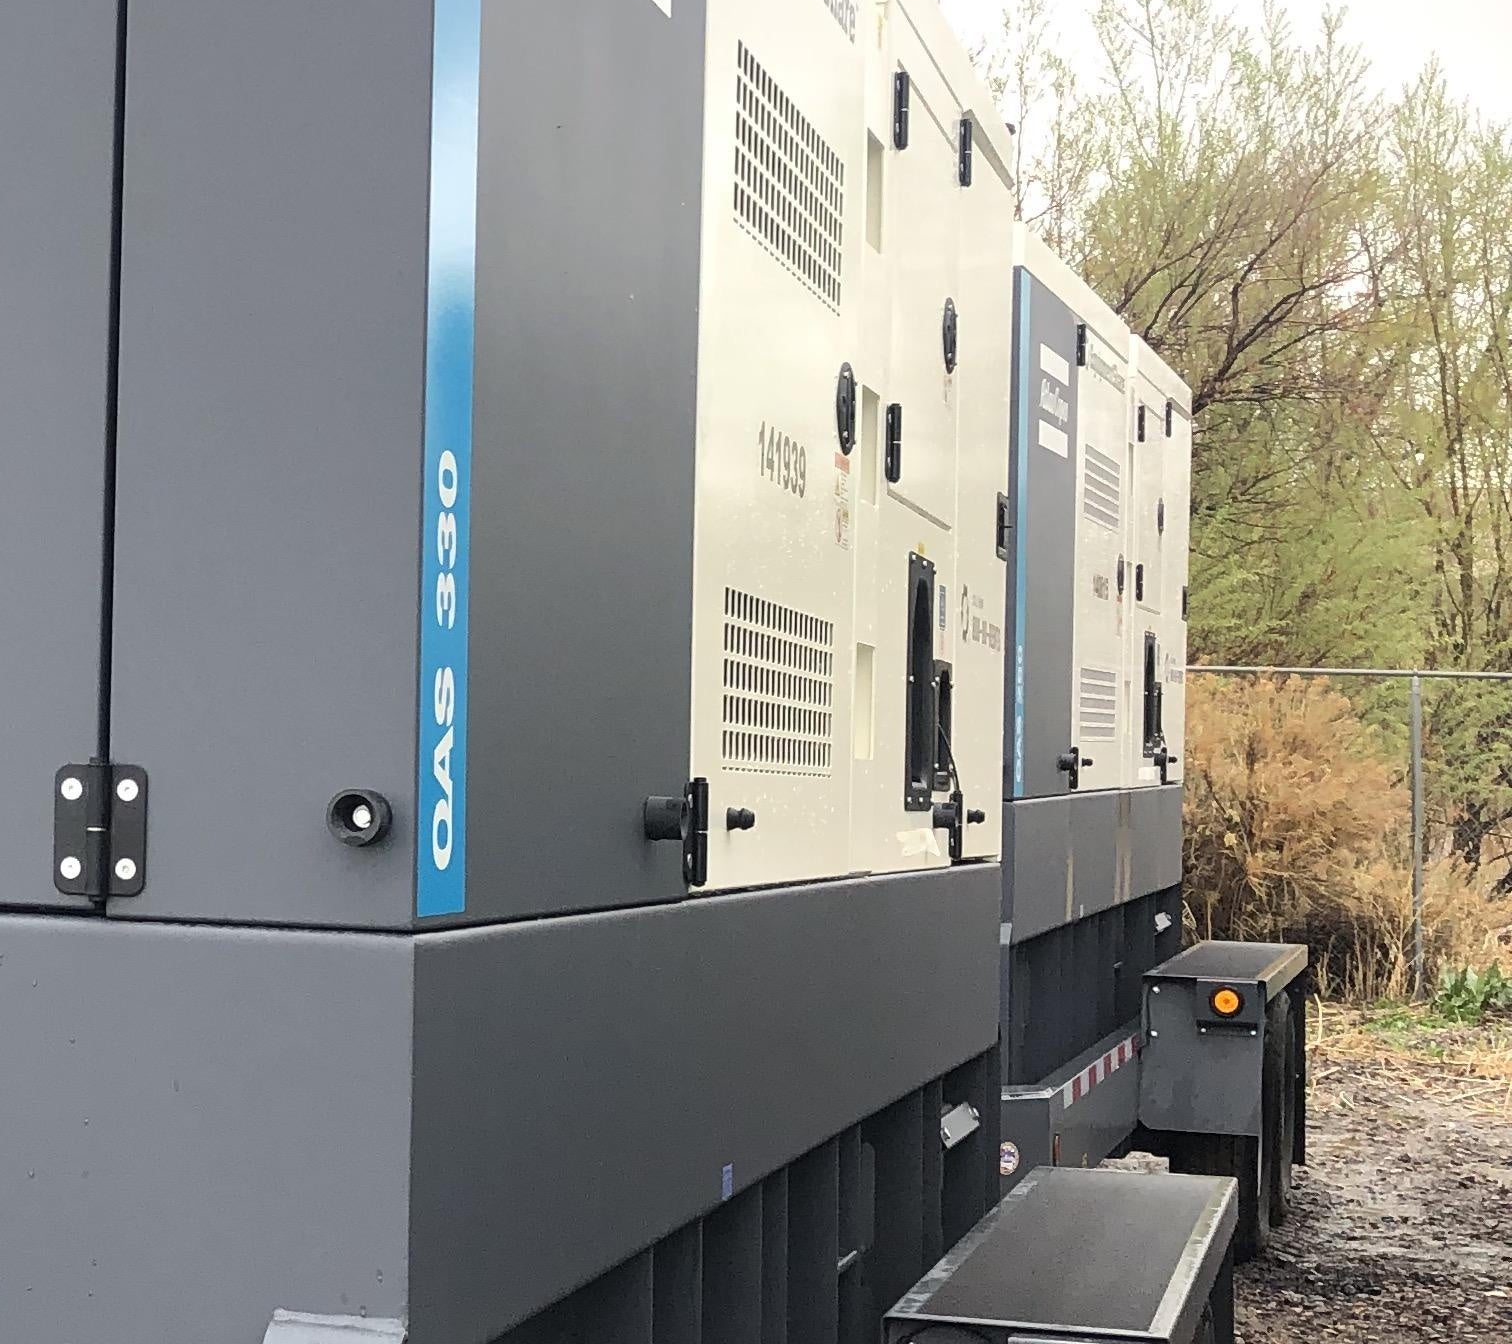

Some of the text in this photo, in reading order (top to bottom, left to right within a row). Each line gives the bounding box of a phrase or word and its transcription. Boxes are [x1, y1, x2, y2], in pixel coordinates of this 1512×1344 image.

[758, 420, 807, 498] 141939
[432, 449, 458, 870] QAS 330
